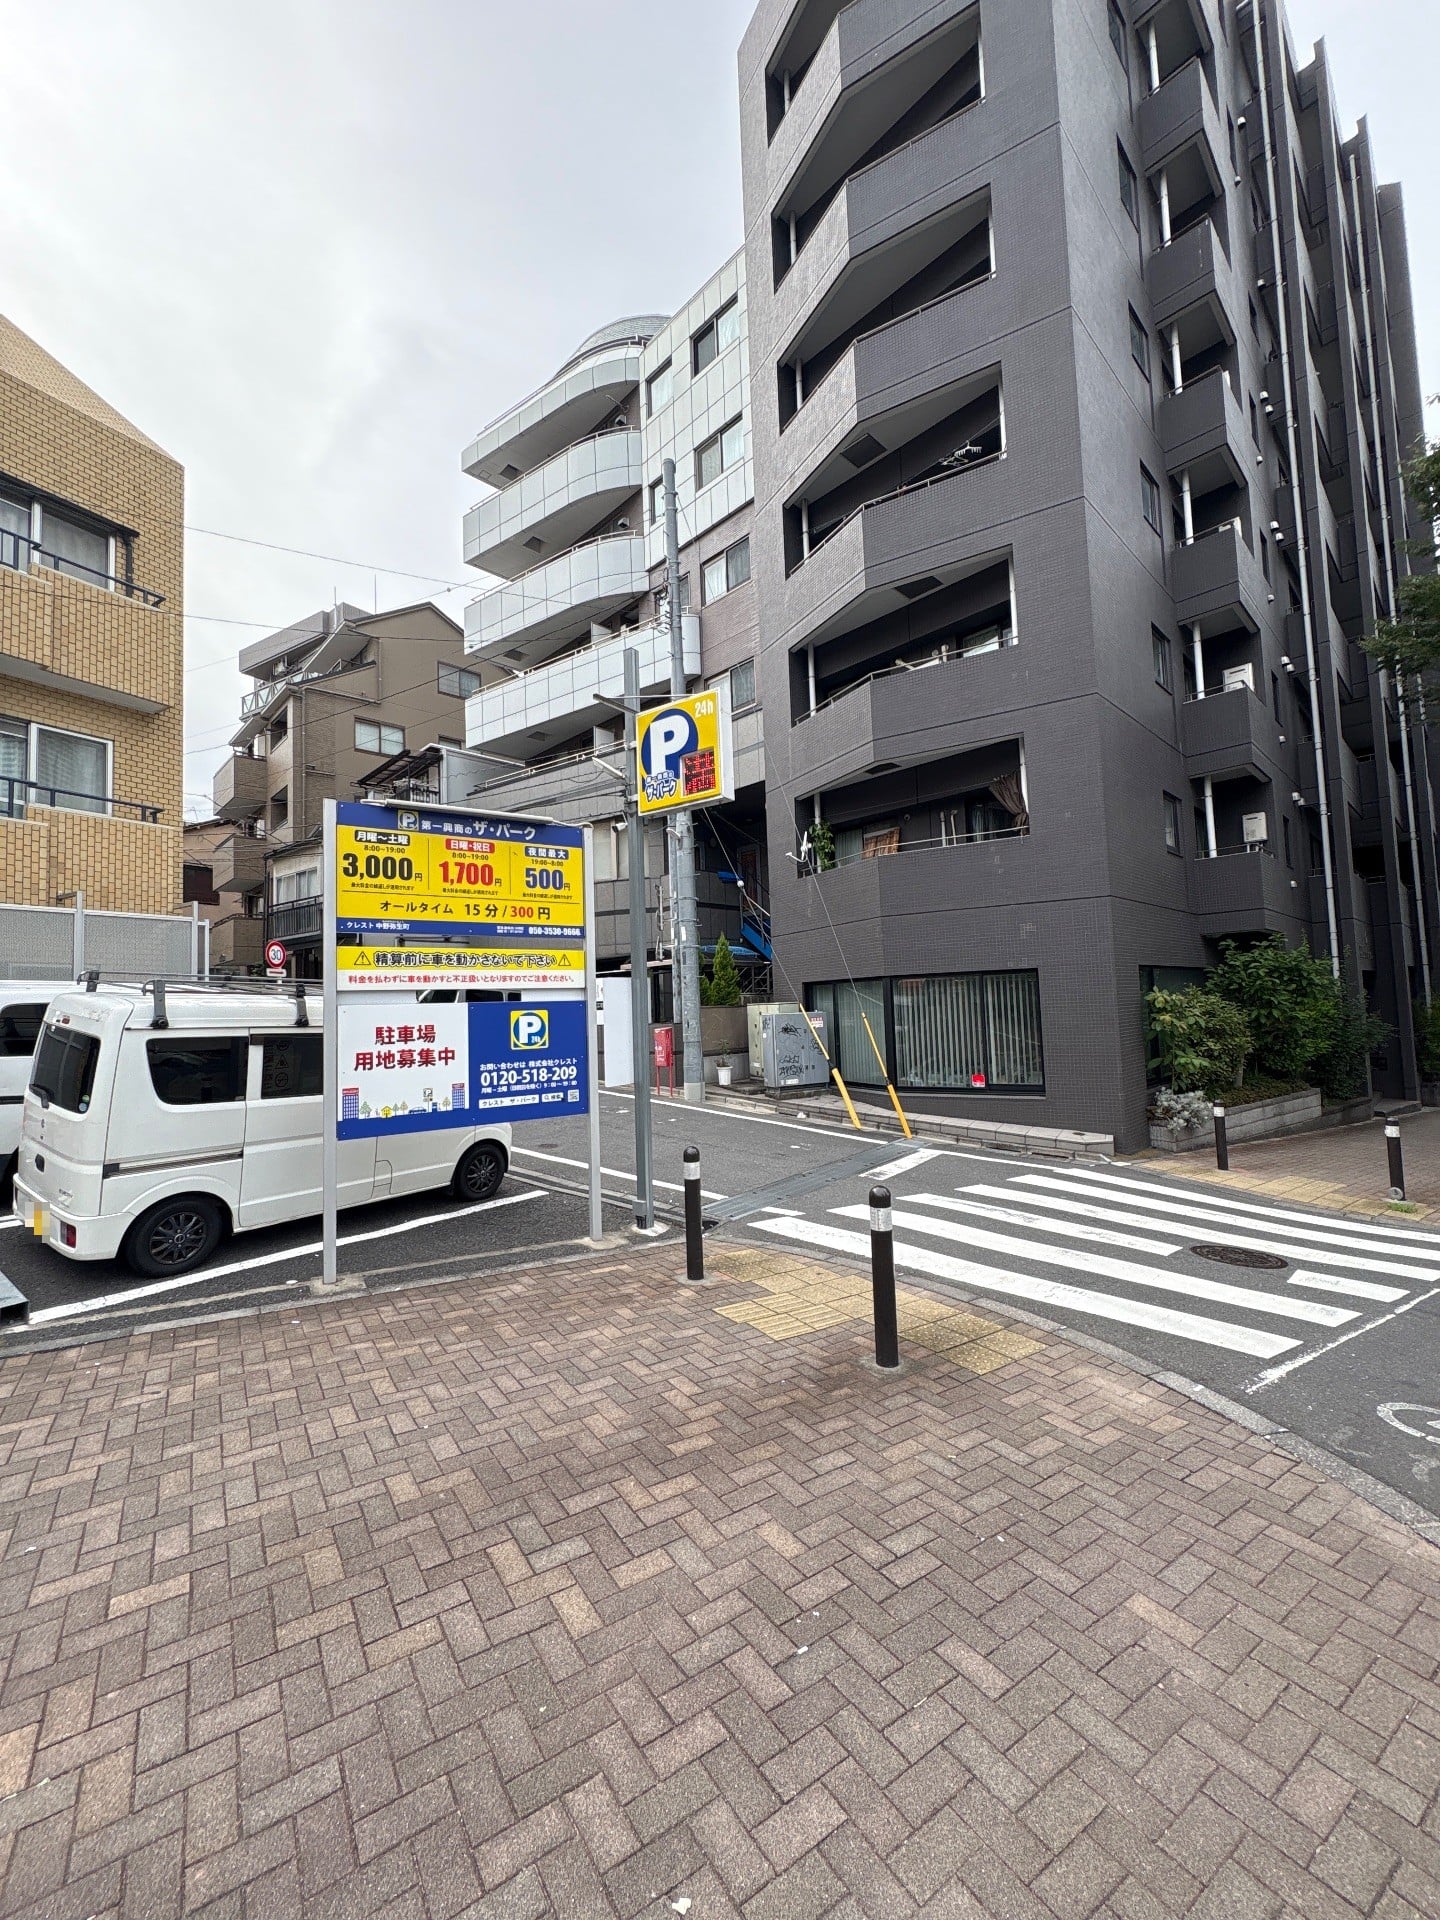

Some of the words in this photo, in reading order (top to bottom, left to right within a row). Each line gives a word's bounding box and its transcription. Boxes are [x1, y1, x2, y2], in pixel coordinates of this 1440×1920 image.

[695, 700, 713, 717] 24h
[650, 715, 689, 776] P
[528, 847, 566, 859] 夜間最大
[342, 853, 422, 881] 3,000円
[439, 861, 502, 887] 1,700円
[525, 867, 570, 891] 500円
[380, 901, 454, 914] オールタイム
[271, 949, 282, 962] 30
[375, 951, 556, 968] 精算前に車を動かさないで下さい
[375, 1025, 436, 1045] 駐車場
[519, 1016, 542, 1043] P
[354, 1047, 455, 1071] 用地募集中
[480, 1061, 526, 1071] お問い合わせは
[529, 1058, 577, 1068] 株式会社クレスト
[480, 1066, 577, 1086] 0120-518-209
